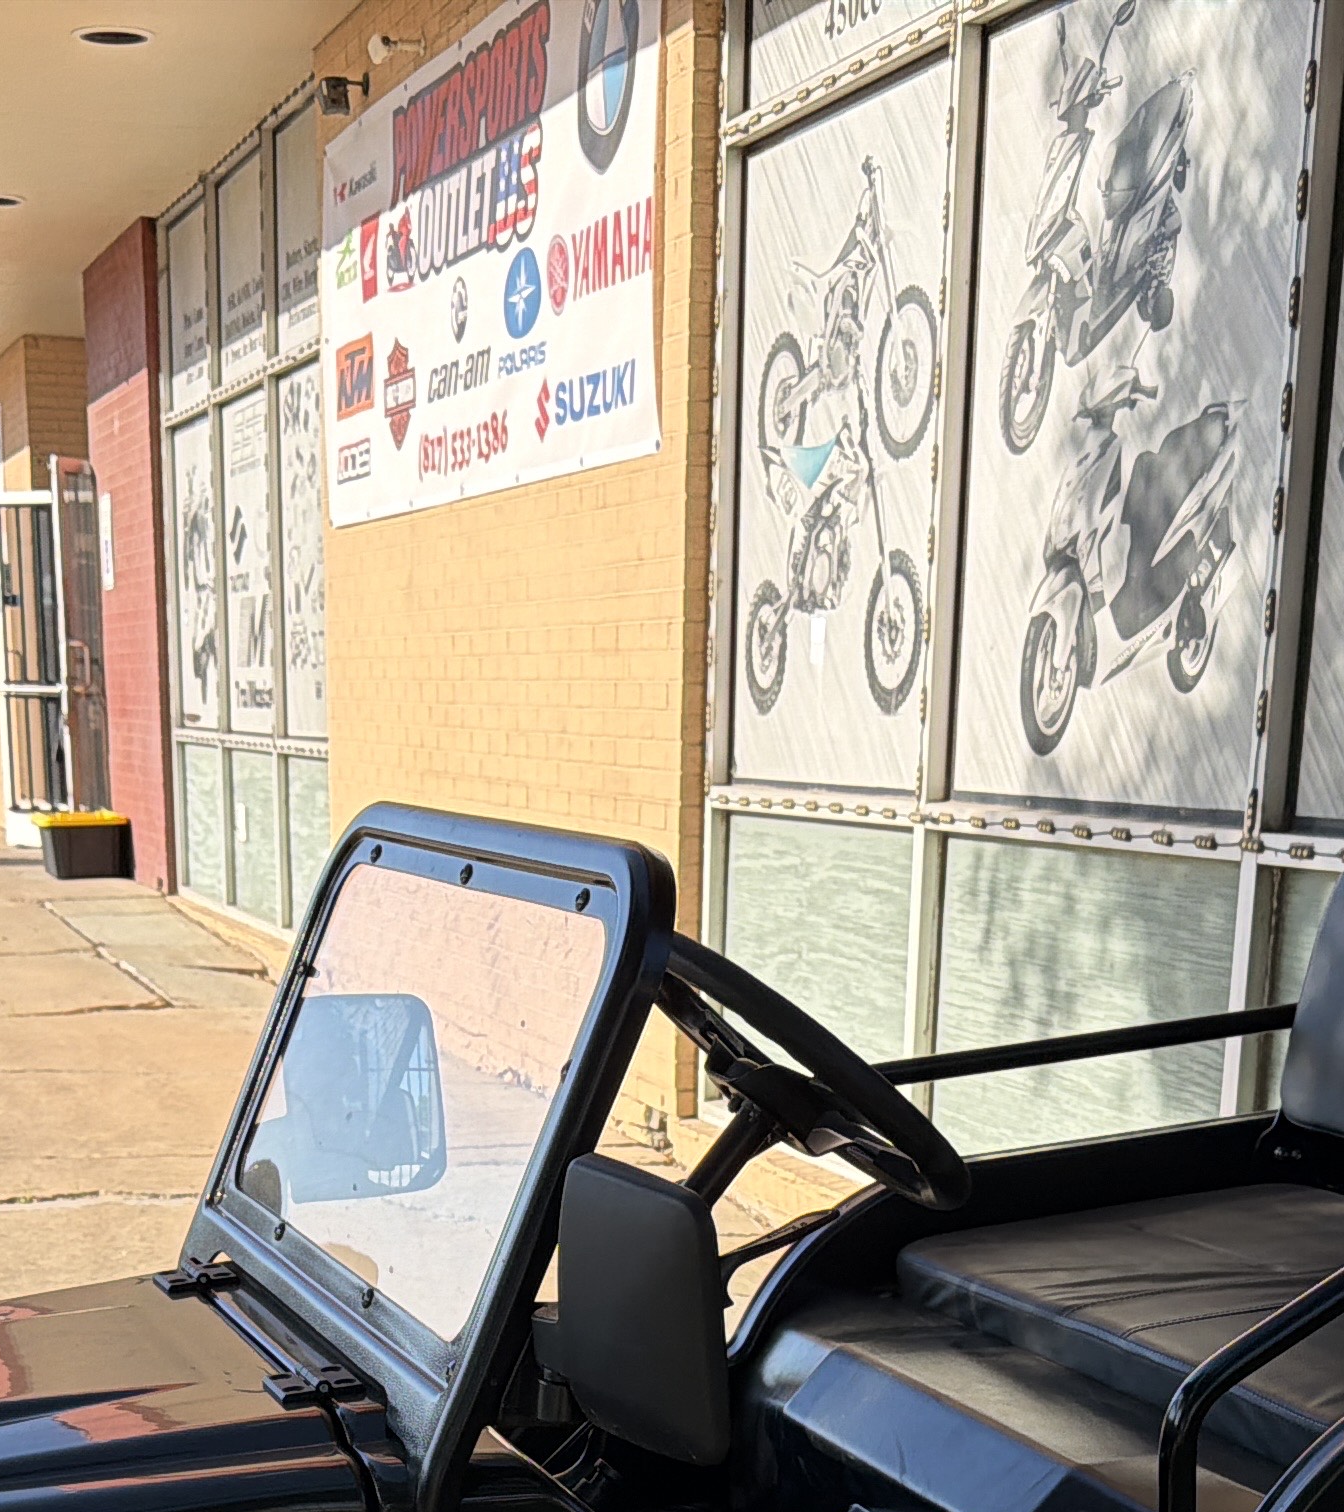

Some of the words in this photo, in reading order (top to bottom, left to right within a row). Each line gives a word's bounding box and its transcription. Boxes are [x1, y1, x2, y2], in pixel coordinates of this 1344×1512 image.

[390, 2, 550, 209] POWERSPORTS
[417, 148, 498, 276] OUTLET
[571, 196, 652, 301] YAMAHA
[338, 346, 373, 413] KTM
[428, 346, 491, 403] can-am
[498, 341, 547, 378] POLARIS
[555, 358, 636, 425] SUZUKI
